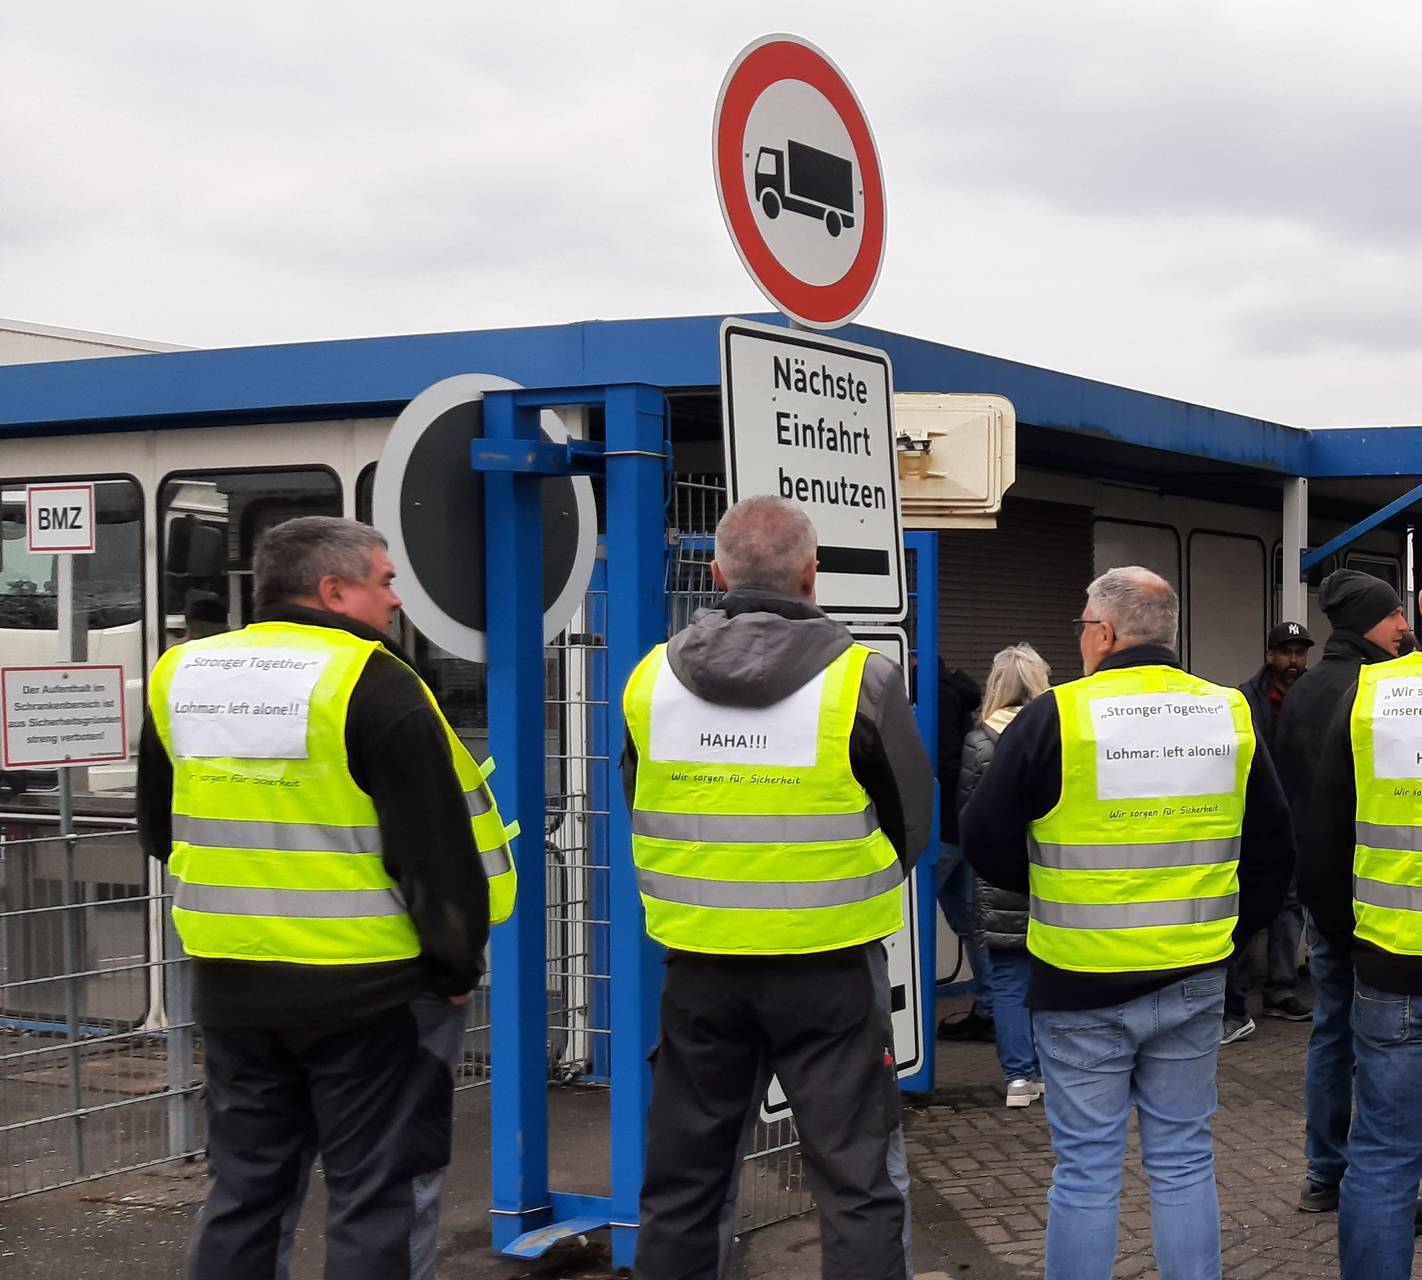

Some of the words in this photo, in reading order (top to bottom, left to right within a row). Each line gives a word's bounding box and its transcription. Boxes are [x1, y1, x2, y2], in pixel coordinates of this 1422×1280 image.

[773, 355, 868, 404] Nächste
[776, 411, 872, 456] Einfahrt
[779, 467, 887, 510] benutzen
[38, 506, 82, 531] BMZ
[22, 686, 40, 694] Der
[1384, 686, 1415, 700] „Wir
[175, 701, 225, 714] Lohmar:
[228, 702, 249, 714] left
[253, 702, 299, 715] alone!!
[1101, 705, 1162, 719] „Stronger
[700, 733, 768, 749] HAHA!!!
[1106, 747, 1160, 760] Lohmar:
[1163, 745, 1186, 758] left
[1188, 744, 1231, 758] alone!!
[671, 771, 688, 781] Wir
[693, 775, 724, 785] sorgen
[729, 774, 745, 785] für
[750, 774, 801, 785] Sicherheit
[1393, 787, 1410, 797] Wir
[1109, 808, 1127, 818] Wir
[1130, 809, 1158, 820] sorgen
[1162, 807, 1176, 816] für
[1180, 804, 1219, 815] Sicherheit
